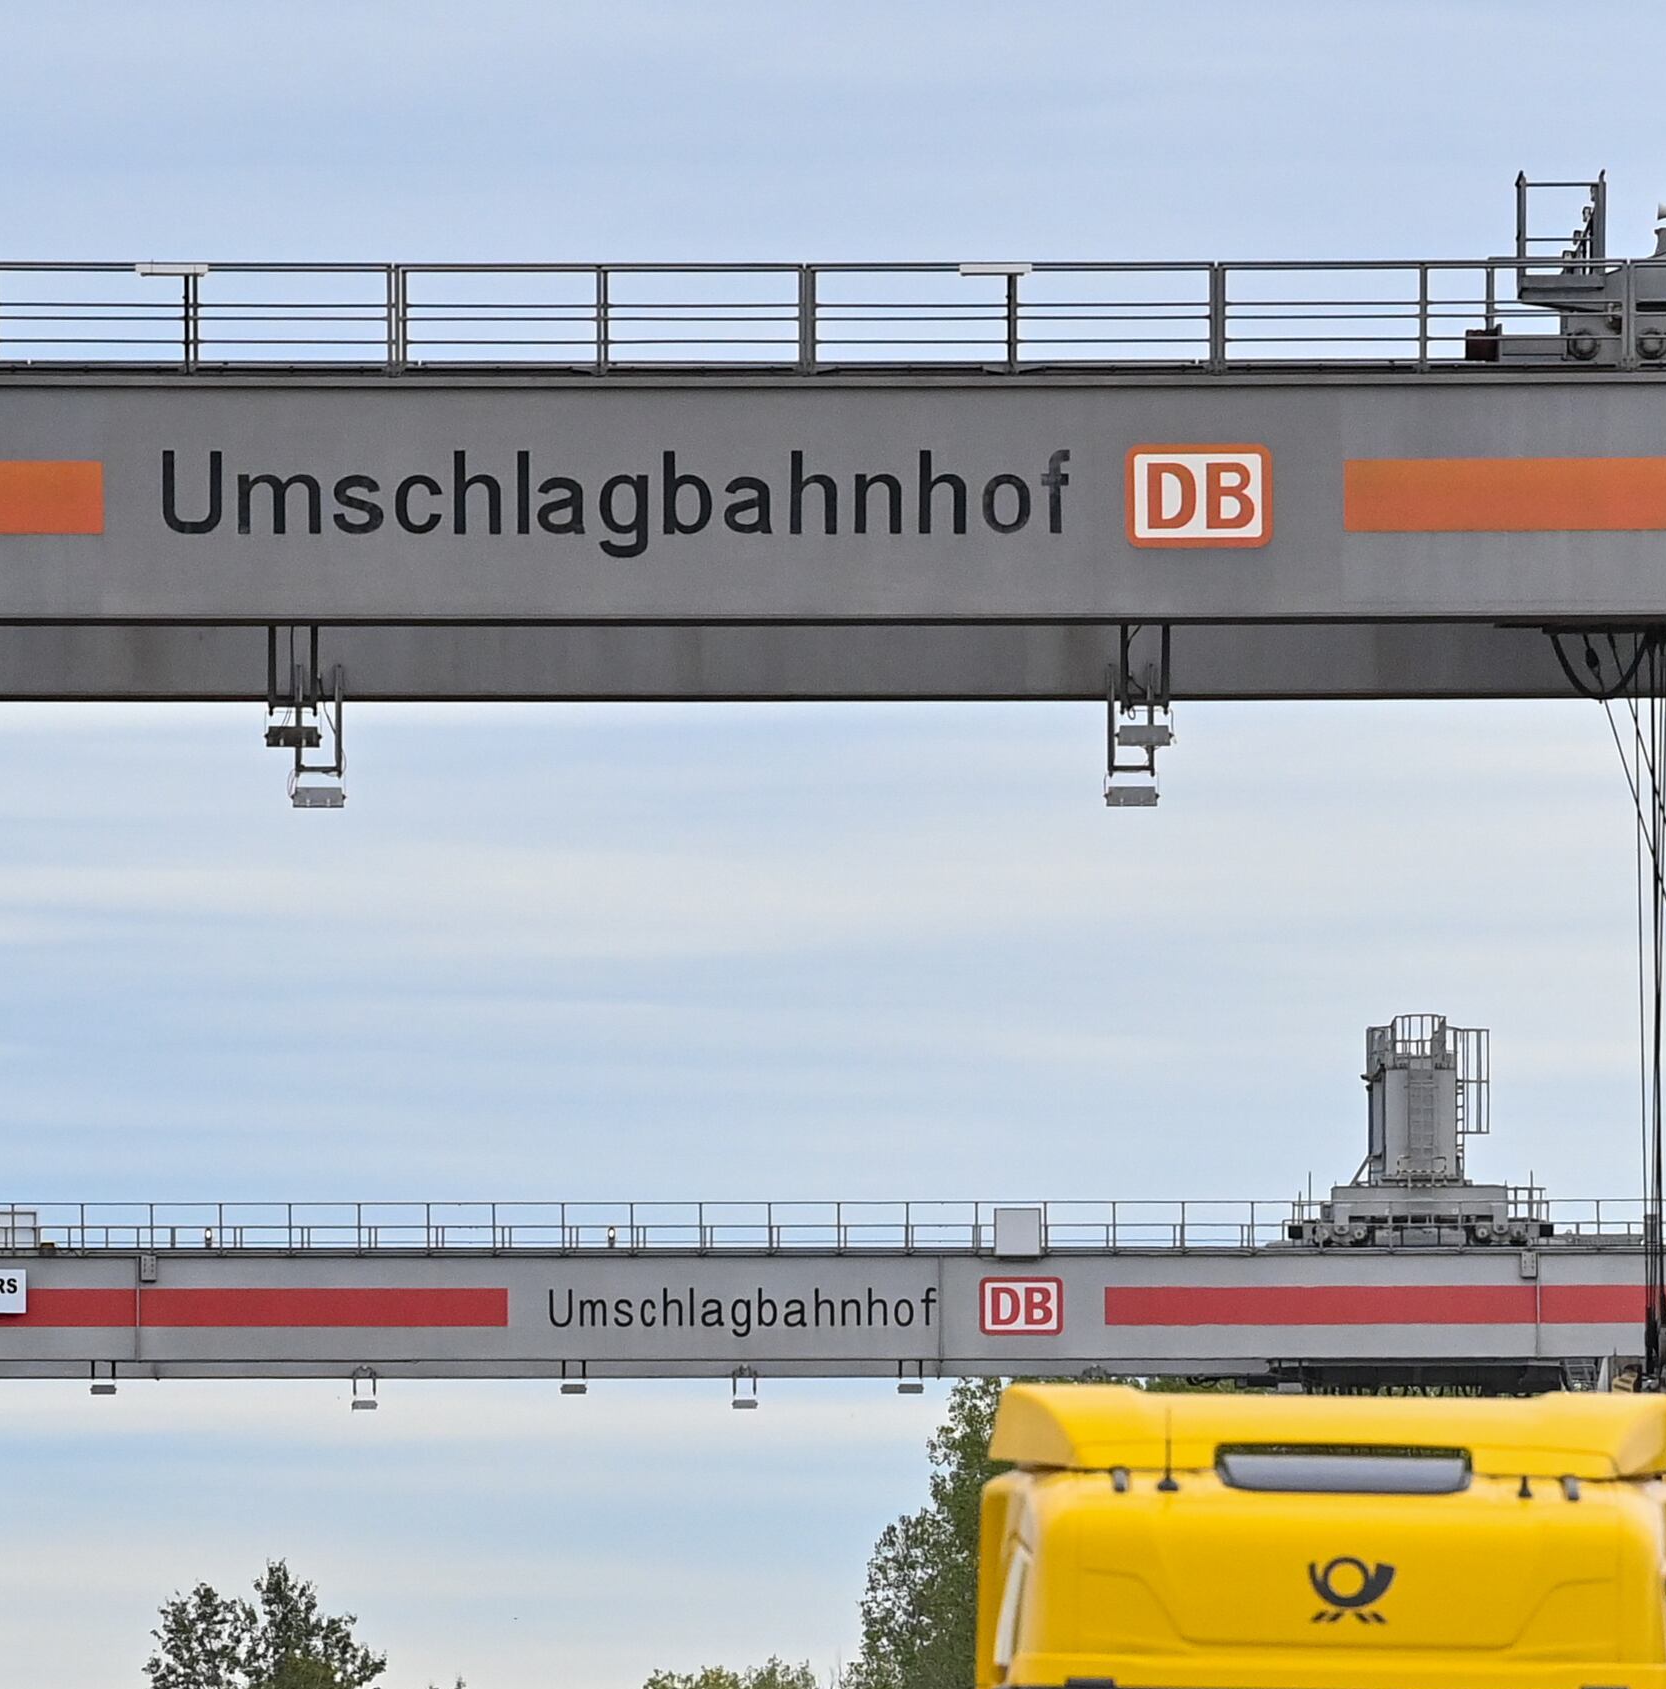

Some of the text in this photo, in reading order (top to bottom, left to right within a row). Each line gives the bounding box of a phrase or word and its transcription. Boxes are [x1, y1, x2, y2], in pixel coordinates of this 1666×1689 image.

[161, 448, 1256, 558] Umschlagbahnhof DB
[548, 1286, 1053, 1338] Umschlagbahnhof DB
